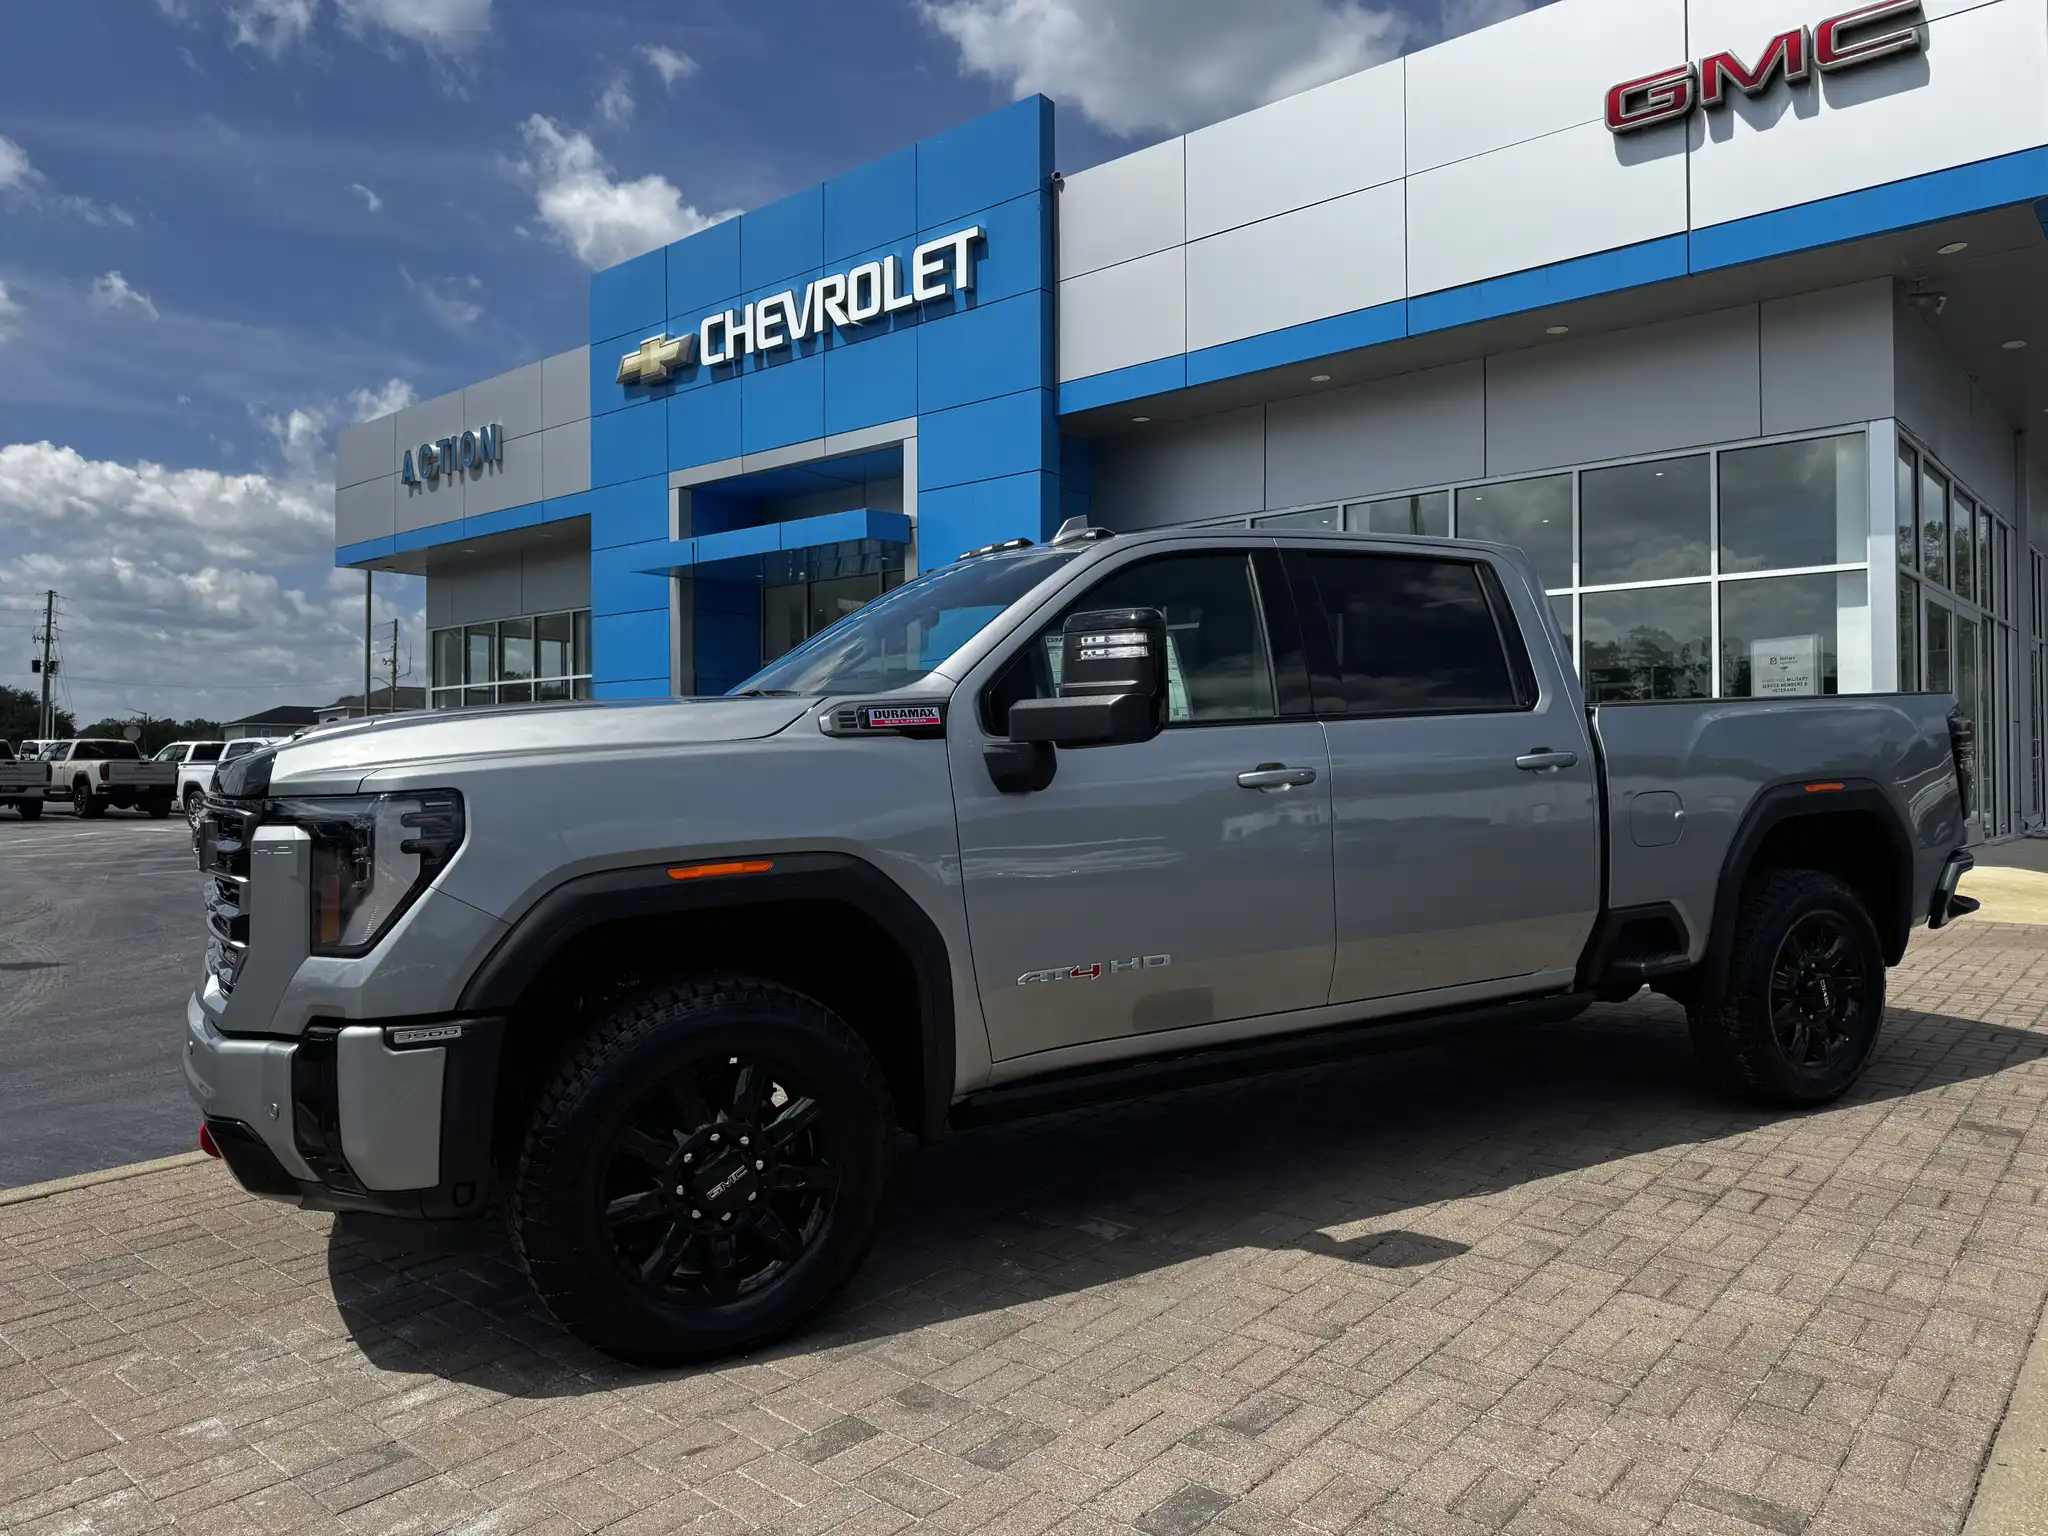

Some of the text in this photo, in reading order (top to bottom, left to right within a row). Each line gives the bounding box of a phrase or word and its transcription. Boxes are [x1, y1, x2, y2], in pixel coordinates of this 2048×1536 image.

[1604, 0, 1920, 133] GMC
[700, 225, 985, 367] CHEVROLET
[401, 423, 502, 485] ACTION
[873, 708, 936, 719] DURAMAX
[1016, 953, 1172, 986] AT4 HD
[396, 1028, 460, 1041] 3500
[706, 1164, 749, 1201] GMC
